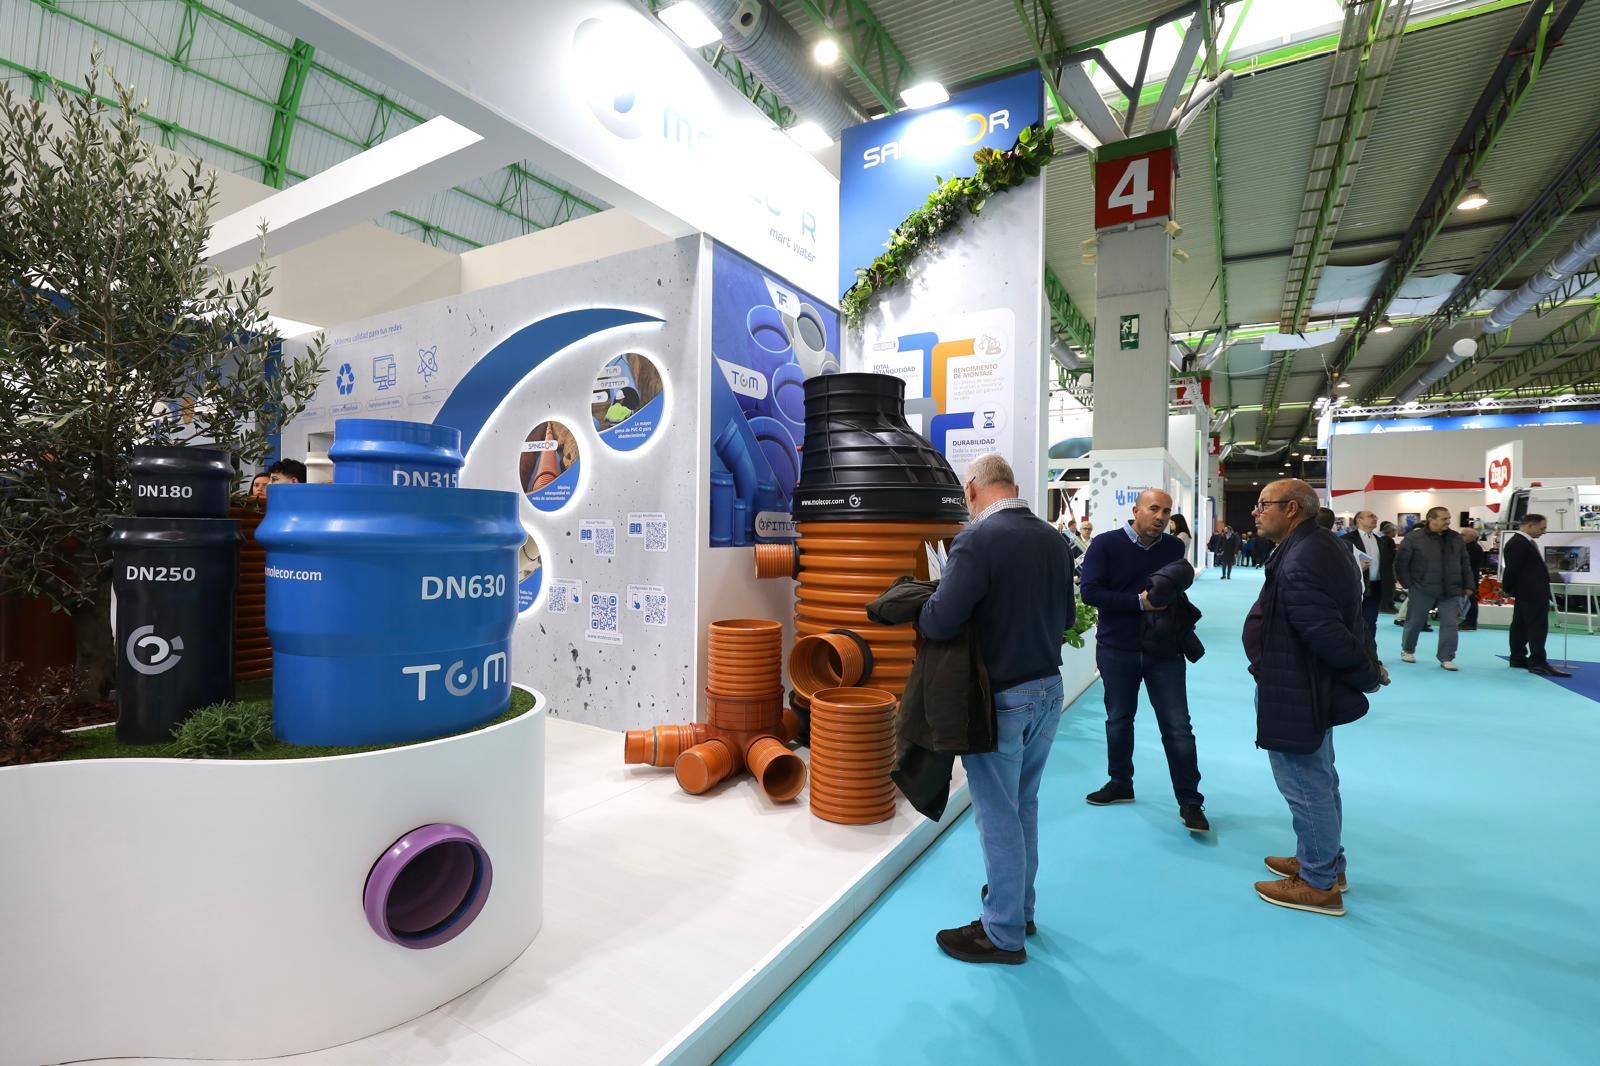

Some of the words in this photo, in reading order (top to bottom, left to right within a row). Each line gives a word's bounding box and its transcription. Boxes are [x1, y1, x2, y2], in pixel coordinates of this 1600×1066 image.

[863, 109, 1009, 169] SAOR
[1108, 157, 1154, 215] 4
[793, 242, 817, 262] water
[953, 364, 998, 373] RENDIMIENTO
[963, 370, 992, 379] MONTAJE
[952, 439, 996, 447] DURABILIDAD
[138, 484, 193, 498] DN180
[126, 565, 196, 581] DN250
[421, 574, 506, 600] DN630
